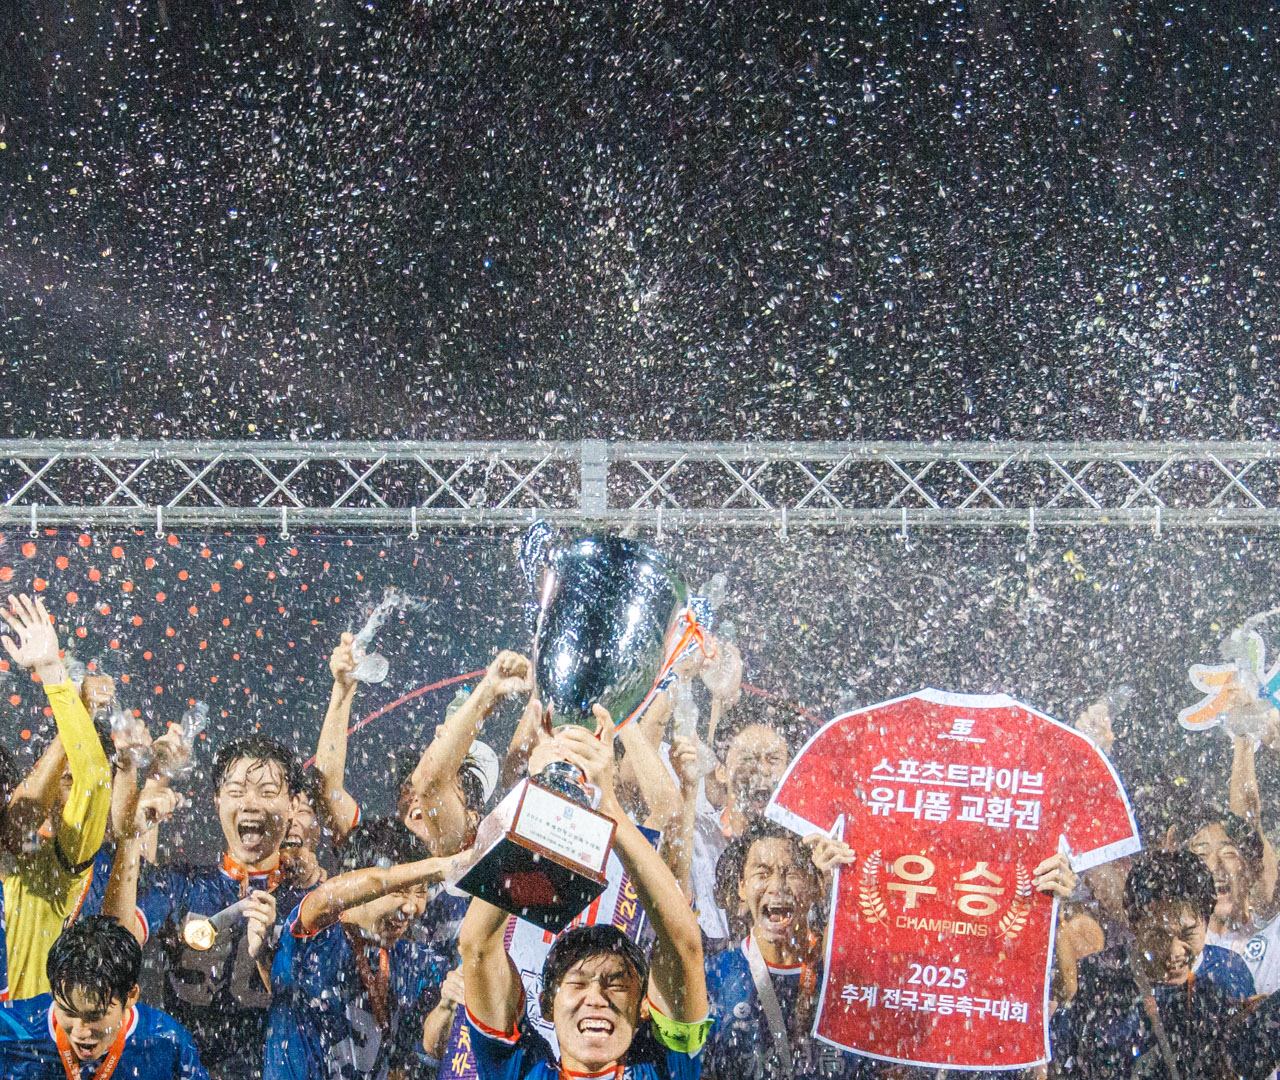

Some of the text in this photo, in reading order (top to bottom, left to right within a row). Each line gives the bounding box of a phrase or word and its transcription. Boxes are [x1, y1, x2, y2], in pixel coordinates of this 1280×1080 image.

[869, 757, 1045, 796] 스포츠트라이브
[867, 786, 1042, 831] 유니폼 교환권
[886, 854, 1005, 917] 우승
[895, 914, 988, 937] CHAMPIONS
[907, 963, 967, 989] 2025
[840, 983, 878, 1008] 추계
[882, 987, 1029, 1023] 전국고등축구대회
[103, 1054, 117, 1073] 2025
